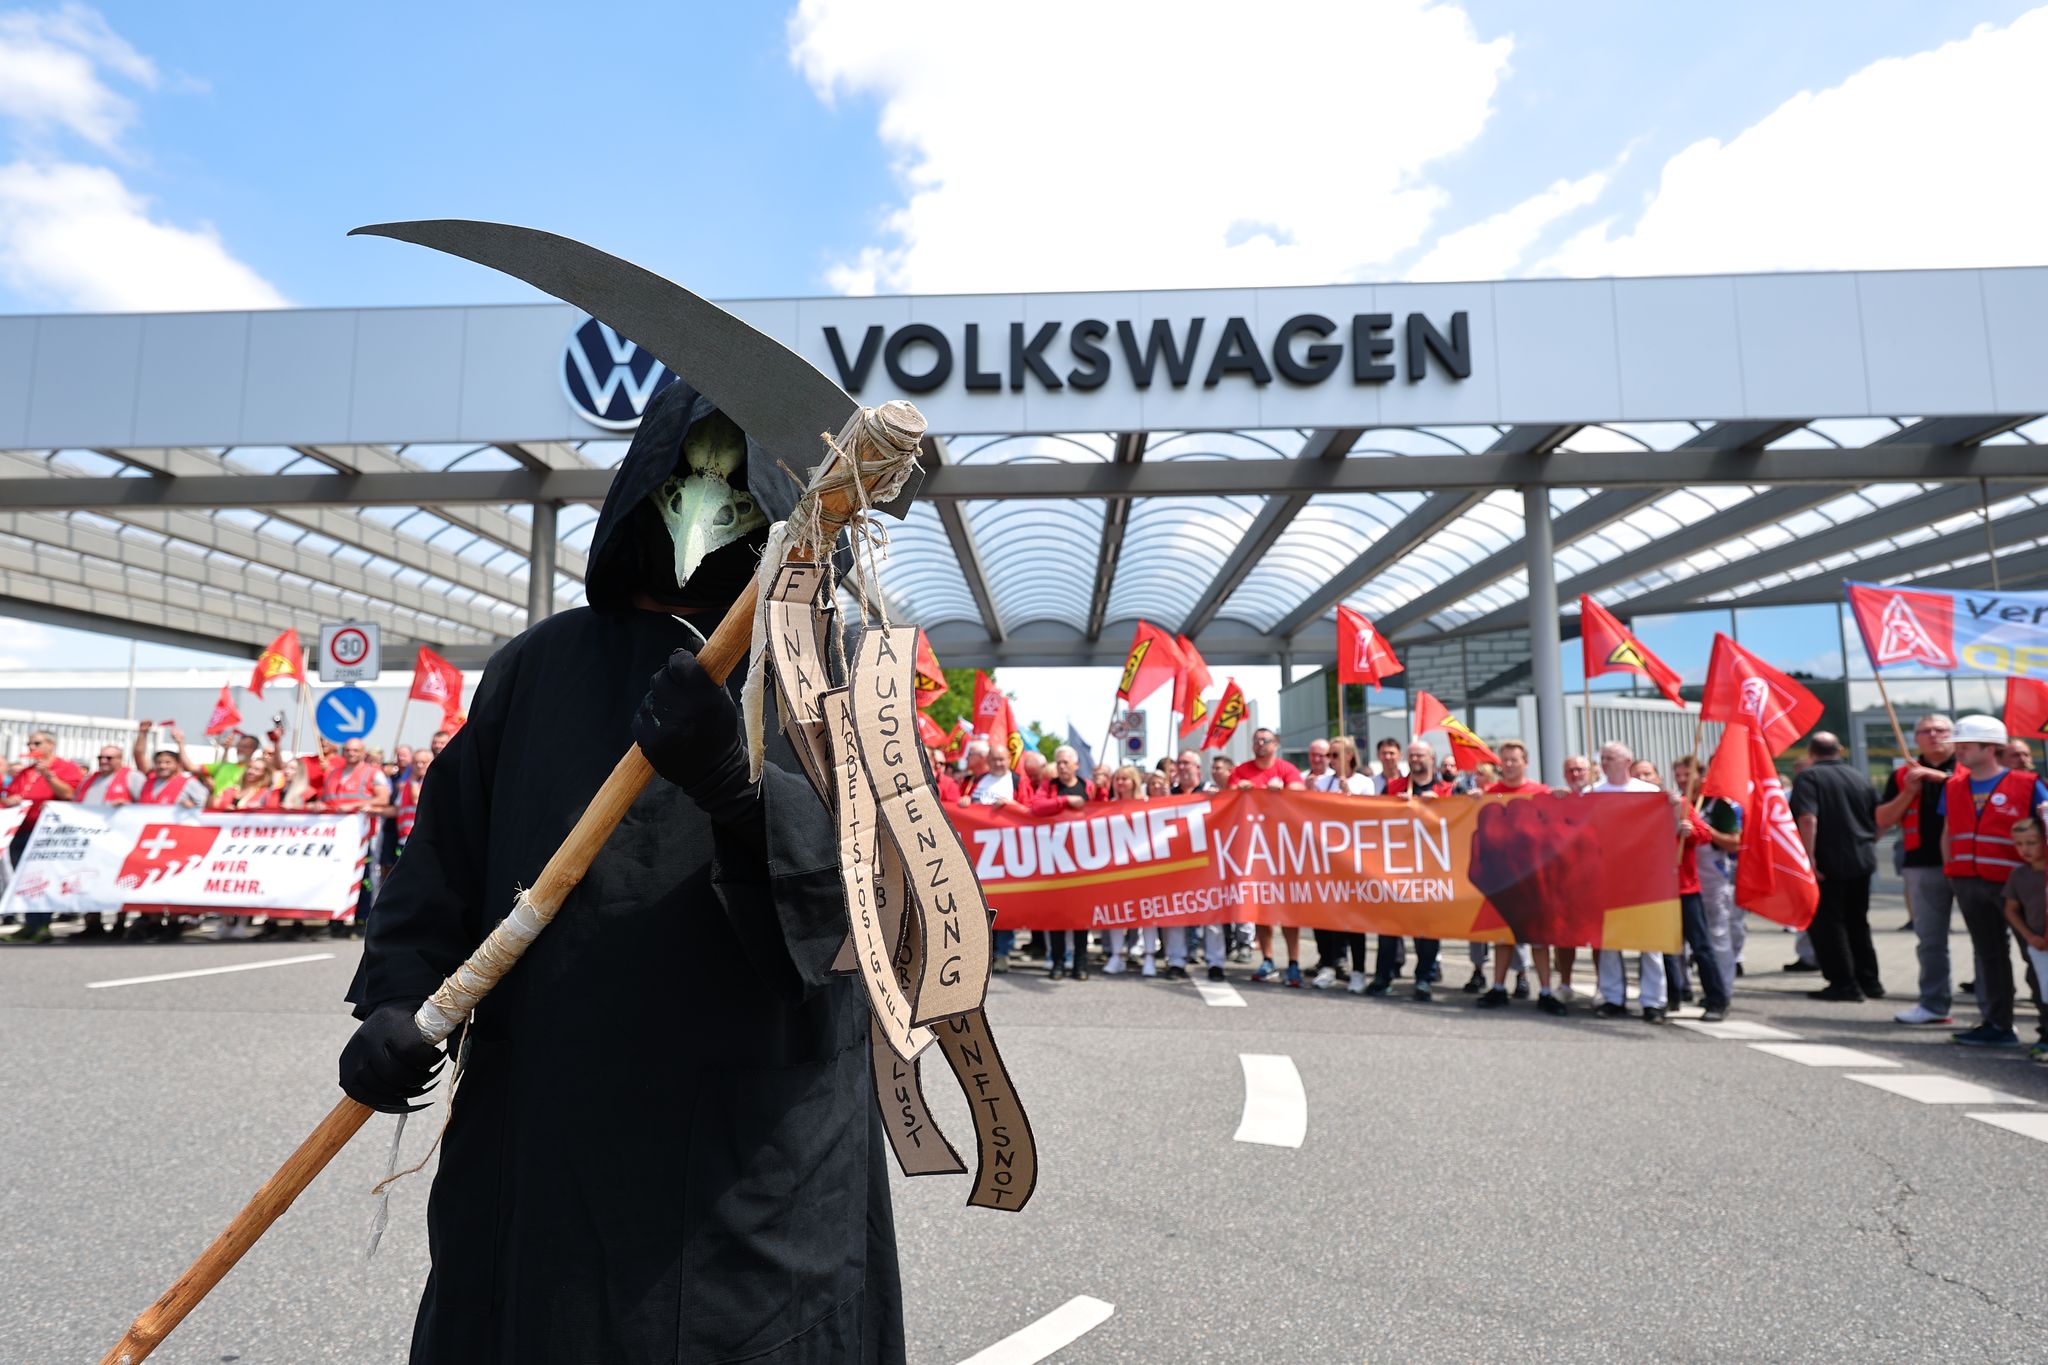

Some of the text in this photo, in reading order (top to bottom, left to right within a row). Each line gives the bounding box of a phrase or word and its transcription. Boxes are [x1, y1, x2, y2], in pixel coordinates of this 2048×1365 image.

[823, 311, 1471, 394] VOLKSWAGEN
[338, 638, 362, 657] 30
[781, 570, 829, 760] FINAN
[876, 635, 962, 988] AUSGRENZUNG
[974, 801, 1451, 880] ZUKUNFT KÄMPFEN
[211, 860, 248, 873] WIR
[840, 699, 915, 1048] ARBEITSLOSIGKEIT
[1092, 878, 1454, 926] ALLE BELEGSCHAFTEN IM VW-KONZERN
